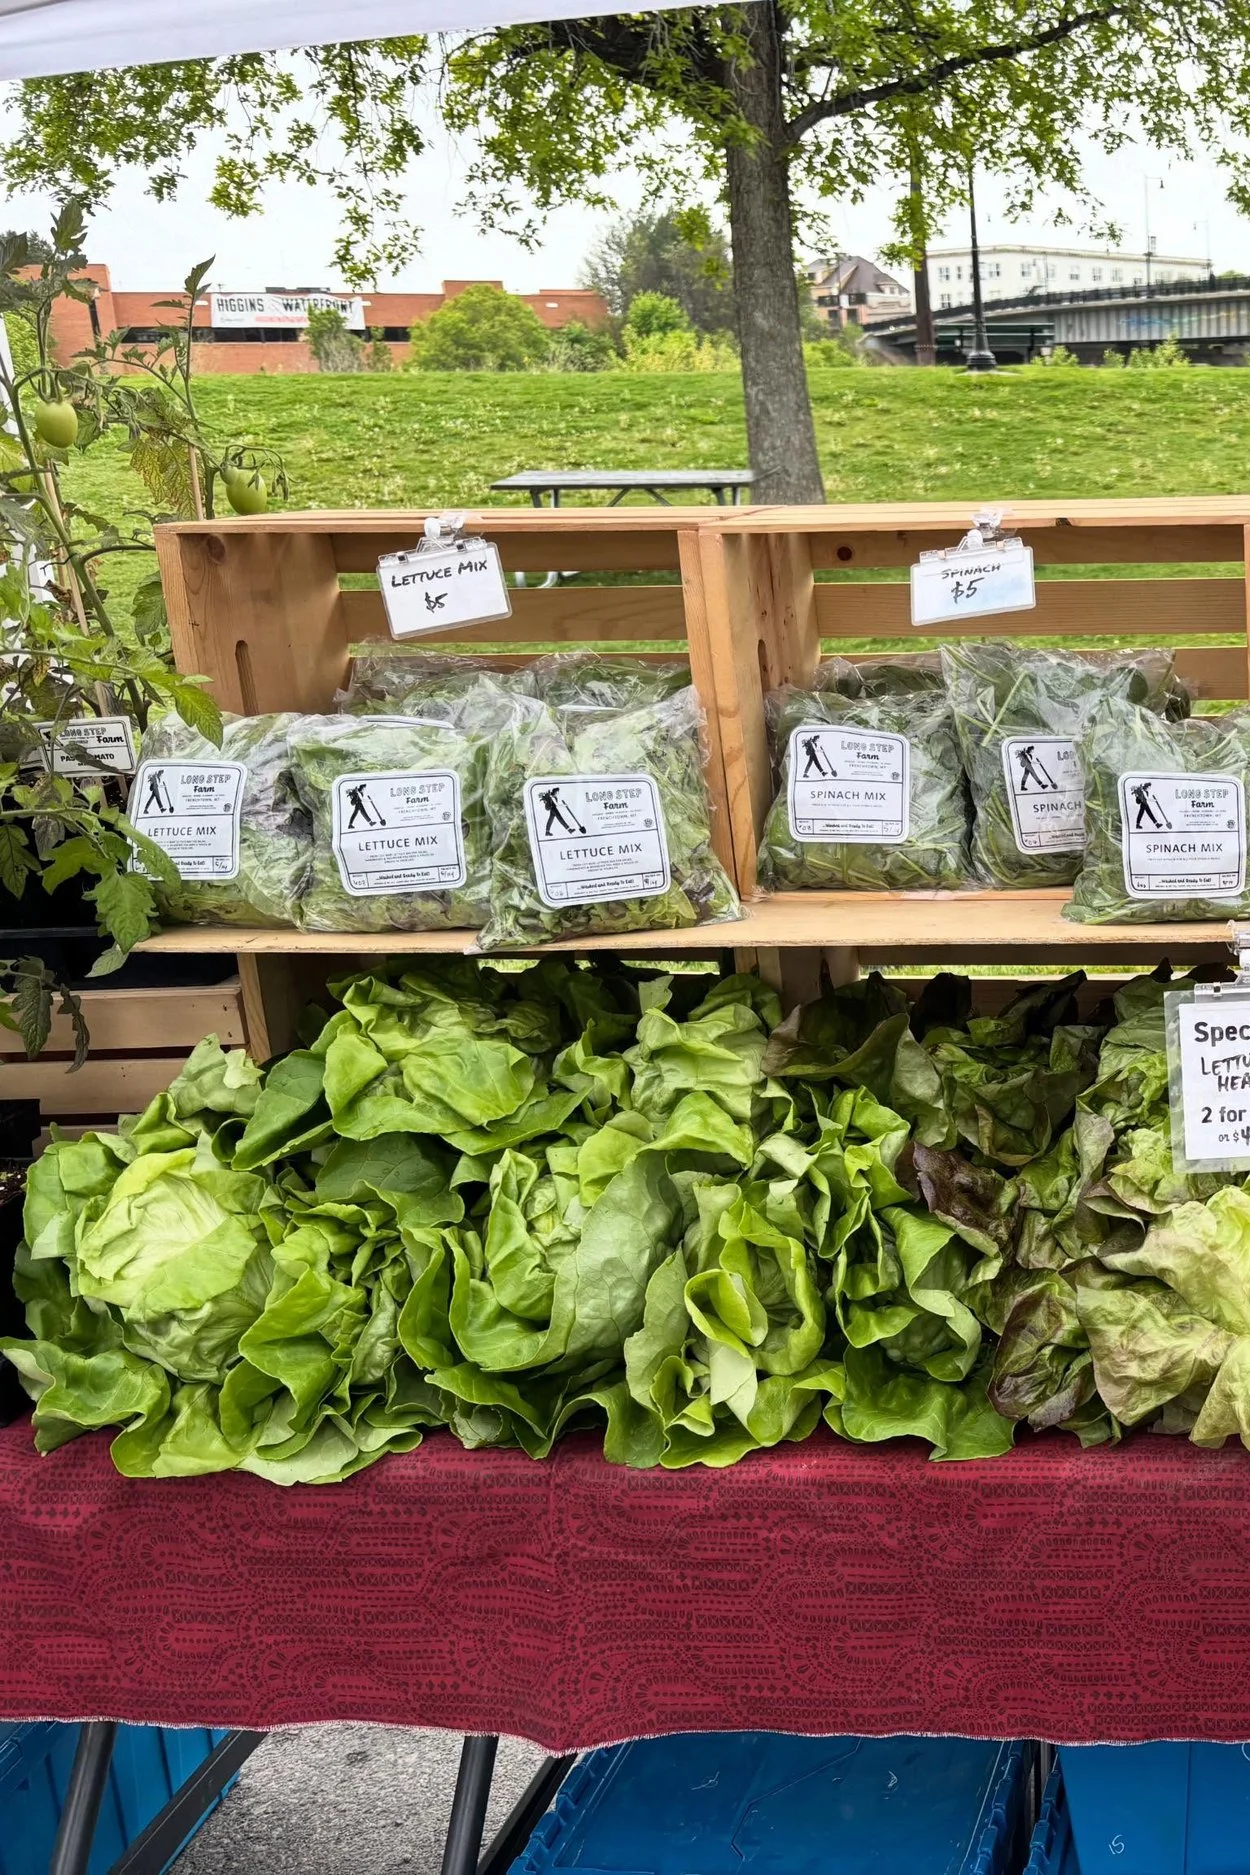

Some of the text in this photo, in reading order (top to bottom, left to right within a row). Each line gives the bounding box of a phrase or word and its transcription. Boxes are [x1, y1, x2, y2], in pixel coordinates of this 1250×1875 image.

[217, 298, 264, 312] HIGGINS
[391, 560, 488, 588] LETTUCE MIX
[941, 563, 1002, 580] SPINACH
[951, 577, 985, 604] $5
[424, 591, 449, 613] $5
[84, 727, 107, 736] STEP
[96, 736, 125, 744] Farm
[840, 740, 895, 753] LONG STEP
[856, 752, 880, 760] Farm
[180, 774, 232, 785] LONG STEP
[193, 785, 216, 794] Farm
[390, 783, 445, 798] LONG STEP
[585, 788, 642, 803] LONG STEP
[810, 790, 886, 801] SPINACH MIX
[1175, 788, 1229, 799] LONG STEP
[406, 796, 430, 804] Farm
[603, 801, 629, 810] Farm
[1191, 800, 1215, 808] Farm
[1032, 801, 1082, 813] SPINACH
[147, 826, 217, 838] LETTUCE MIX
[358, 836, 438, 852] LETTUCE MIX
[1145, 843, 1223, 854] SPINACH MIX
[559, 843, 643, 861] LETTUCE MIX
[1201, 1106, 1213, 1124] 2
[1218, 1106, 1247, 1123] for
[1218, 1134, 1230, 1142] or
